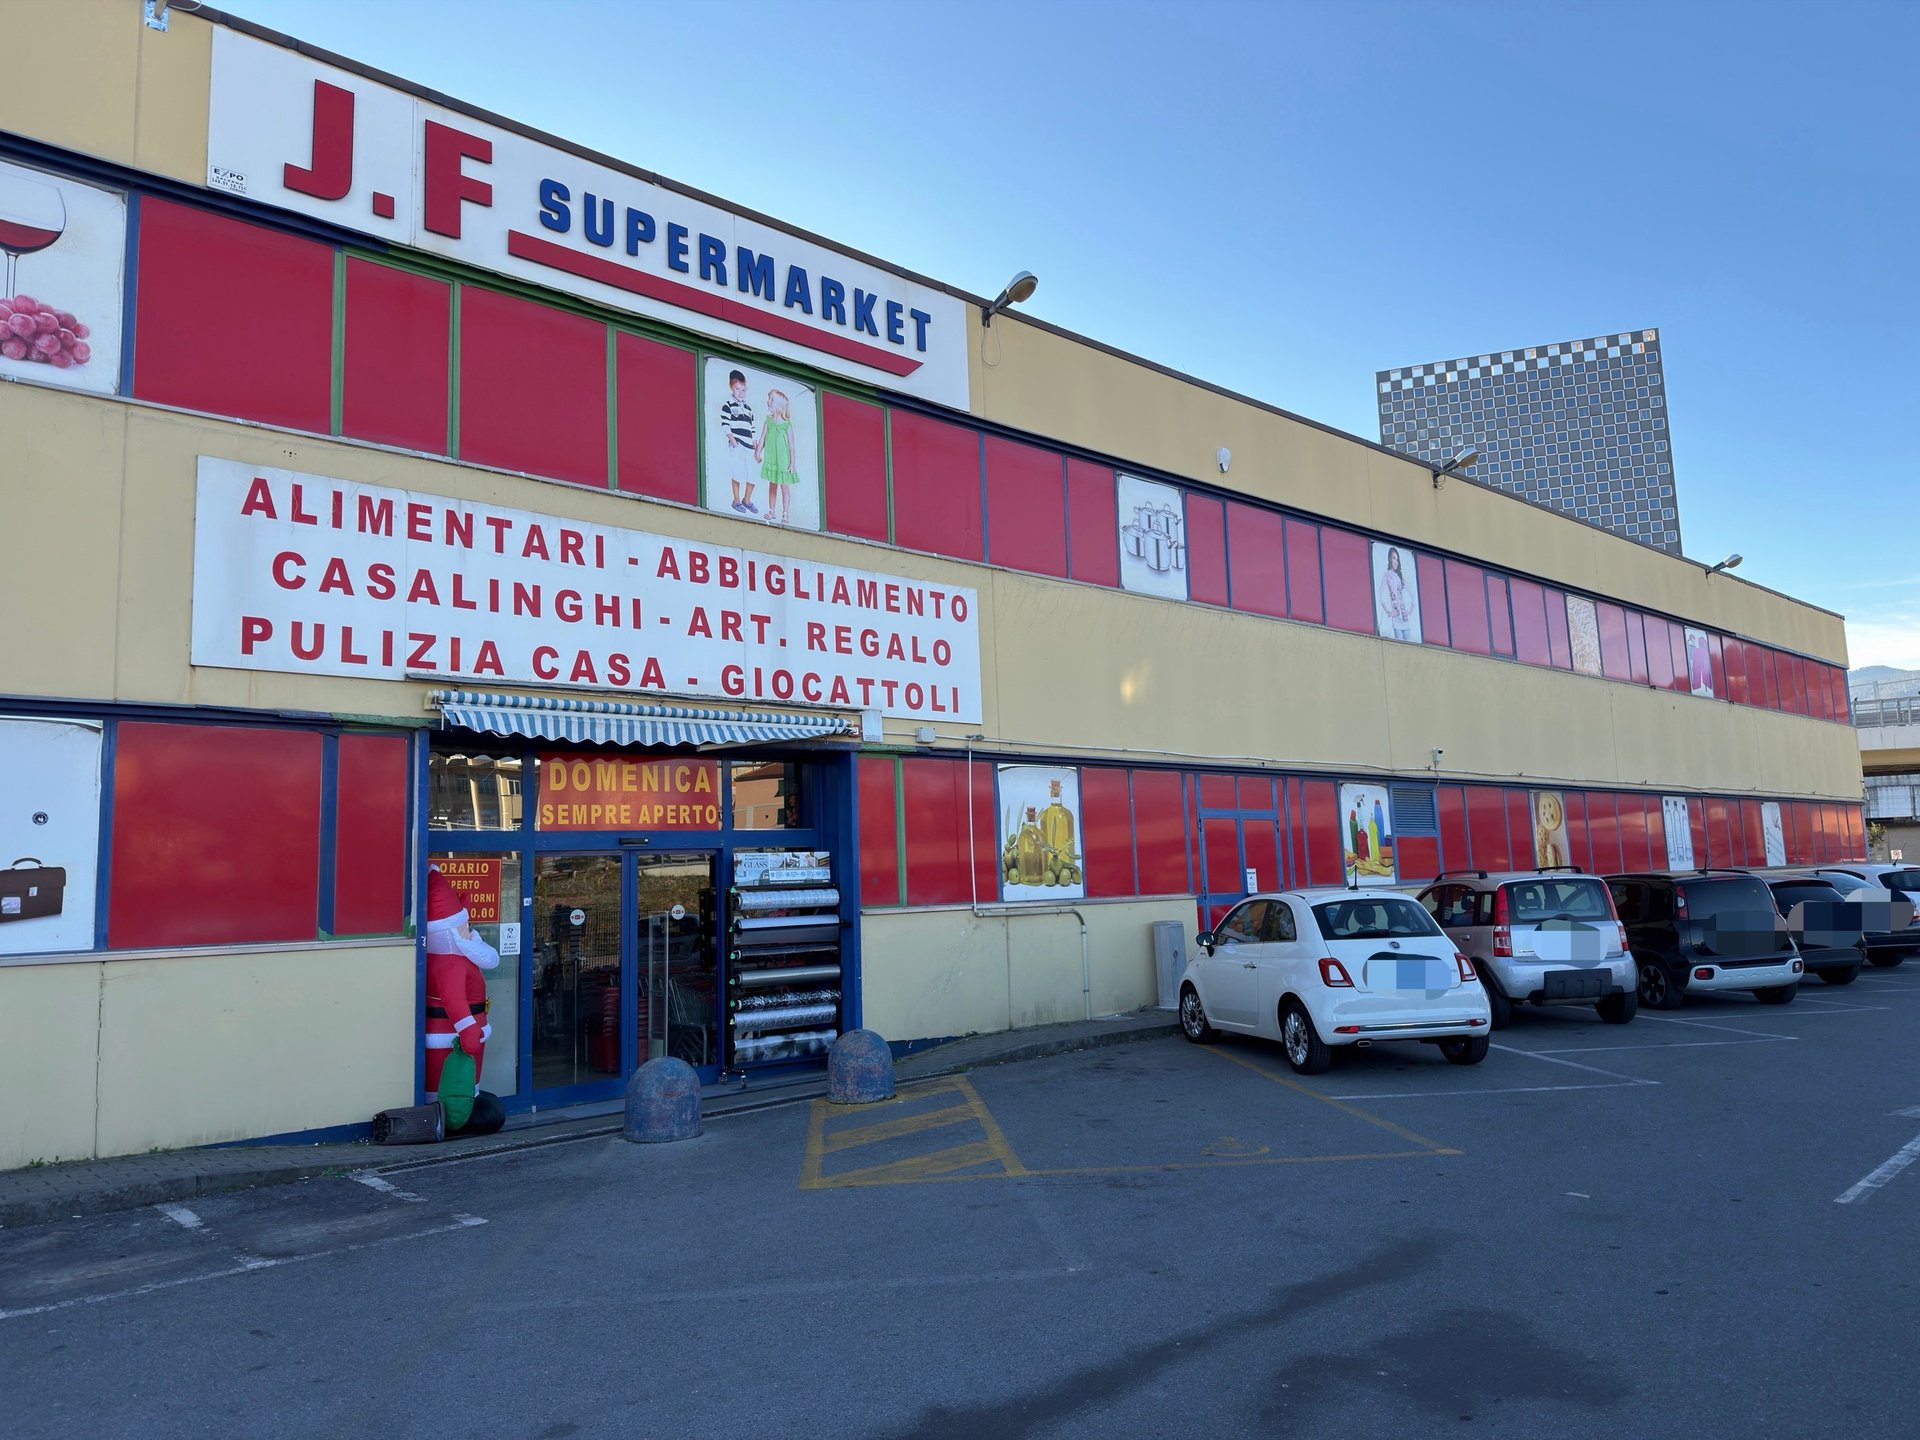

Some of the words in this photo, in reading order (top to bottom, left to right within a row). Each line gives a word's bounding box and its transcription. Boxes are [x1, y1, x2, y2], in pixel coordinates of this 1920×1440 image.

[284, 80, 493, 239] J.F
[539, 178, 931, 352] SUPERMARKET
[241, 477, 604, 569] ALIMENTARI
[656, 547, 969, 622] ABBIGLIAMENTO
[272, 551, 642, 629] CASALINGHI
[688, 607, 787, 648] ART.
[807, 621, 952, 667] REGALO
[241, 616, 505, 676] PULIZIA
[532, 646, 666, 689] CASA
[721, 664, 959, 714] GIOCATTOLI
[550, 762, 711, 793] DOMENICA
[542, 804, 631, 825] SEMPRE
[638, 804, 717, 824] APERTO
[440, 863, 489, 873] ORARIO
[448, 880, 480, 889] PERTO
[470, 893, 495, 903] IORNI
[470, 907, 495, 918] 0.00
